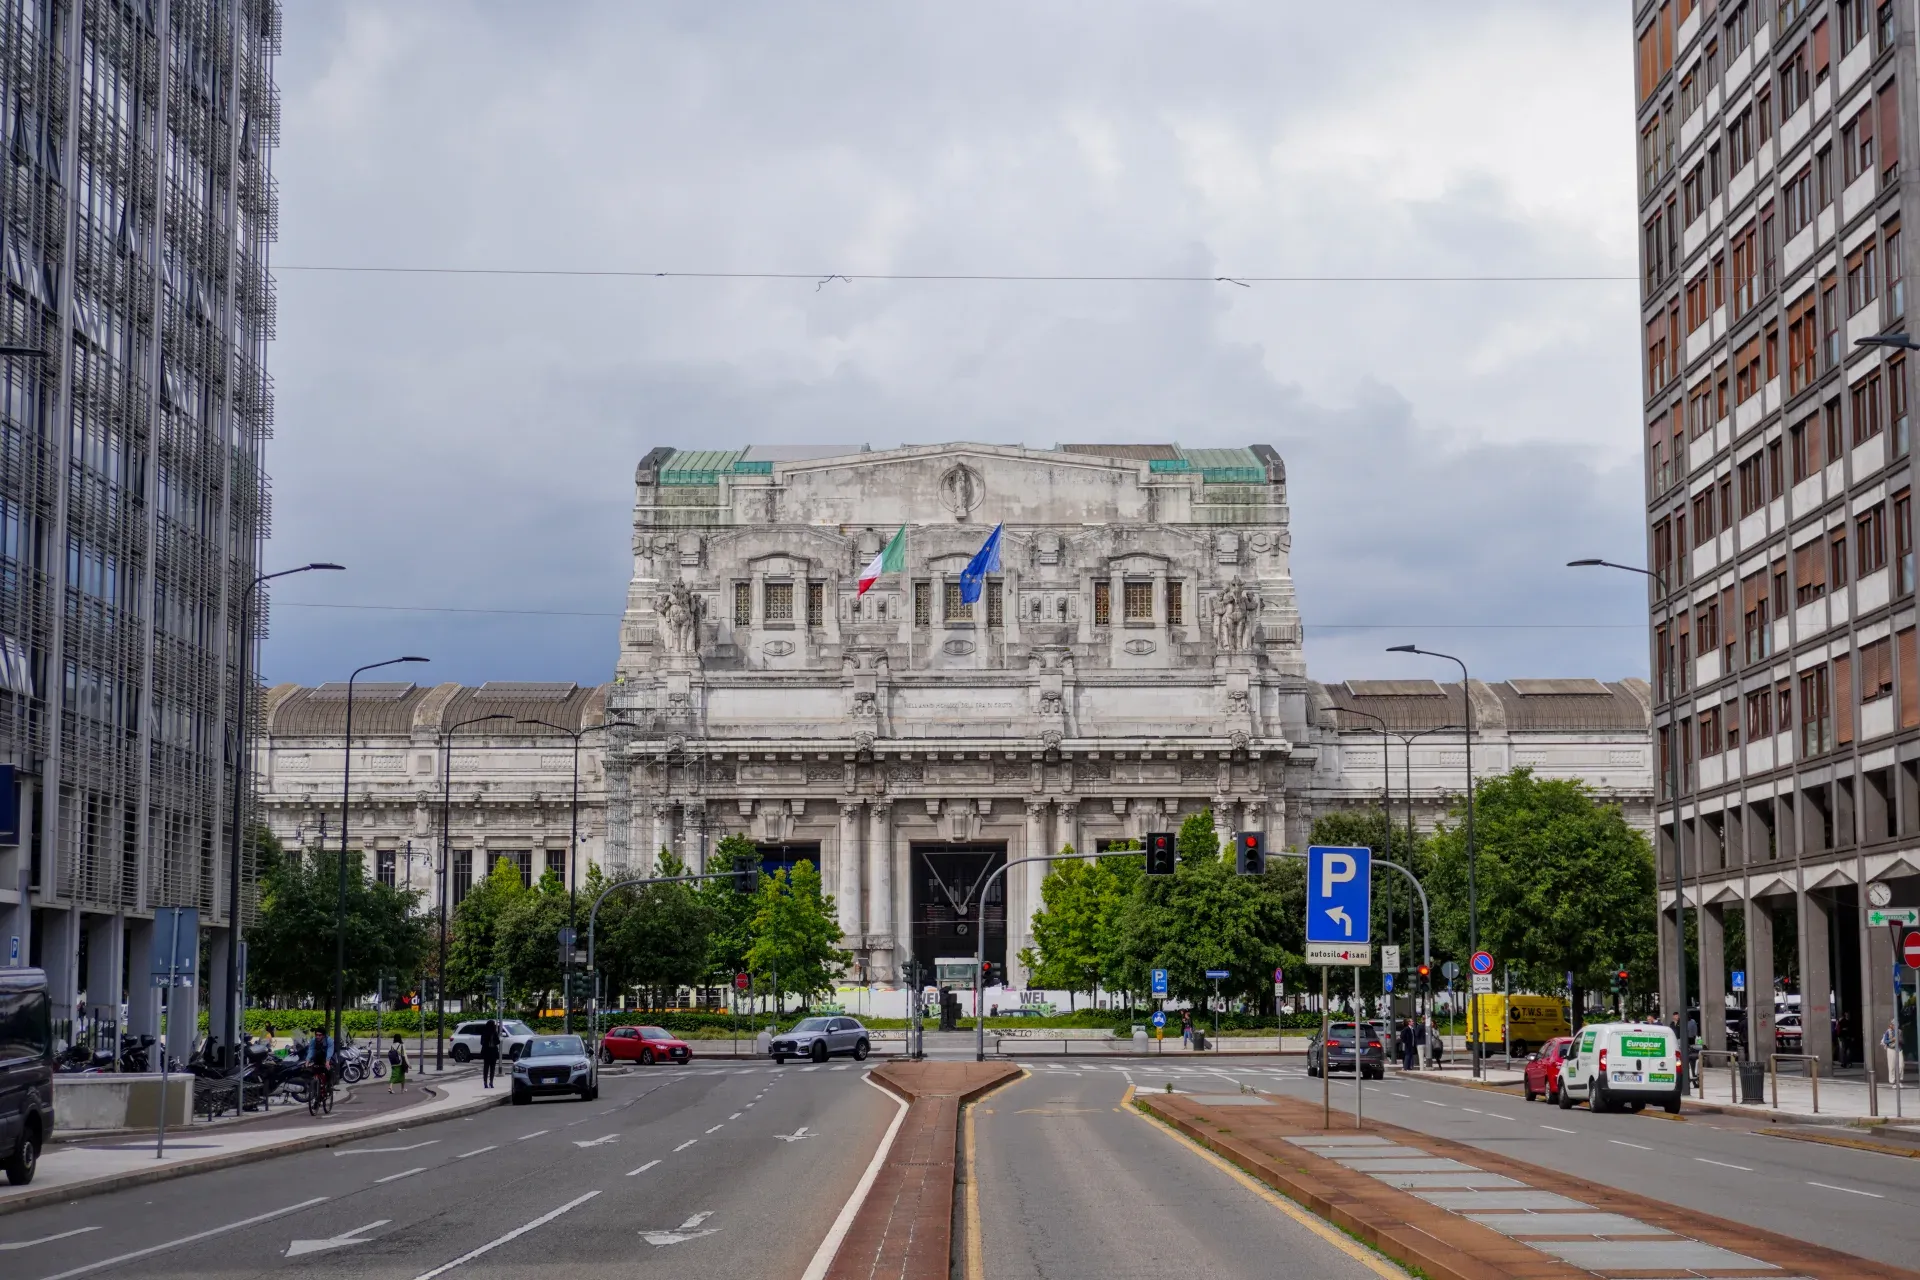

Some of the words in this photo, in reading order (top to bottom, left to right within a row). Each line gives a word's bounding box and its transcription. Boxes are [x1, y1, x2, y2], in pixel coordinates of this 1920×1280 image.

[1321, 853, 1357, 897] P
[1310, 950, 1341, 958] autosilo
[1155, 970, 1164, 983] P
[1020, 991, 1048, 1004] WEL
[1521, 1007, 1544, 1017] T.W.S.
[1626, 1040, 1662, 1049] Europcar
